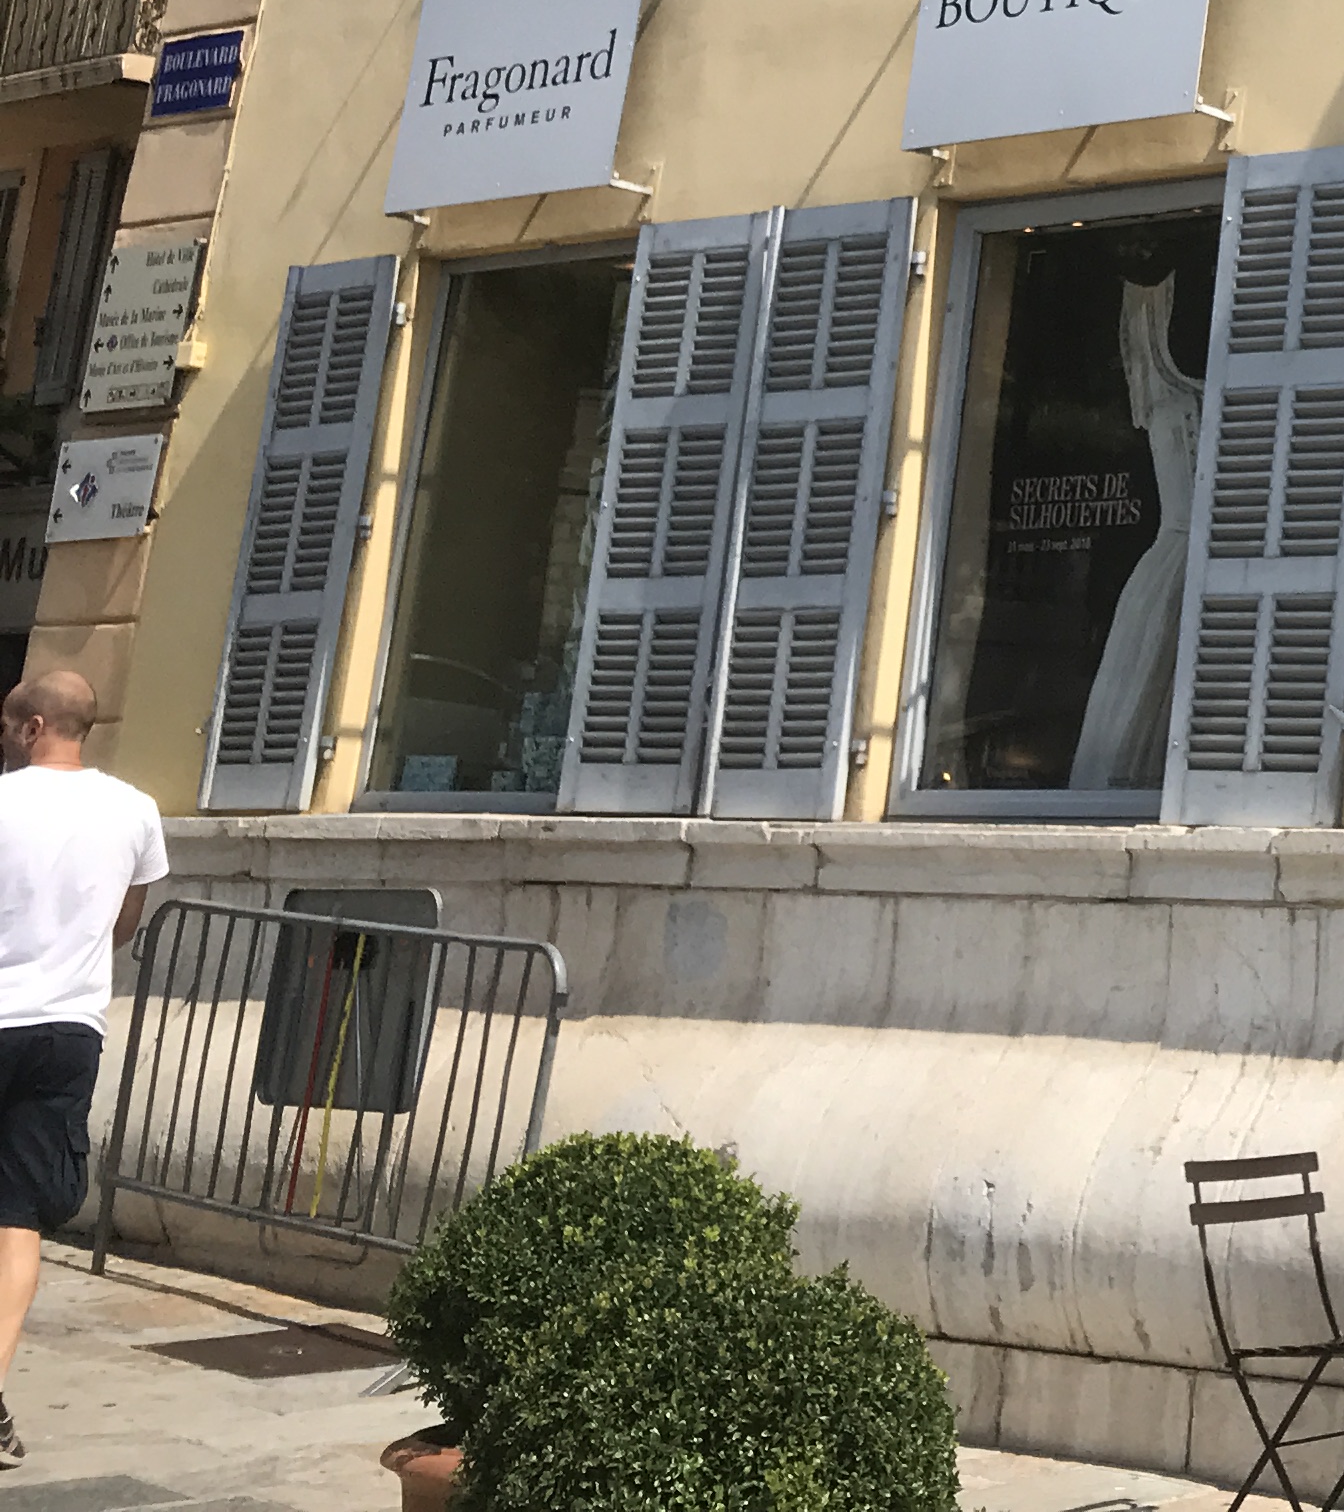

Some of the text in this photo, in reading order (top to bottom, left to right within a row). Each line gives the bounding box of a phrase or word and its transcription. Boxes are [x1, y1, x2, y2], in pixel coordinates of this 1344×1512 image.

[163, 45, 239, 75] BOULEVARD
[418, 27, 618, 114] Fragonard
[156, 75, 232, 105] FRAGONARD
[442, 104, 573, 138] PARFUMEUR
[1010, 472, 1130, 504] SECRETS DE
[1009, 499, 1142, 530] SILHOUETTES
